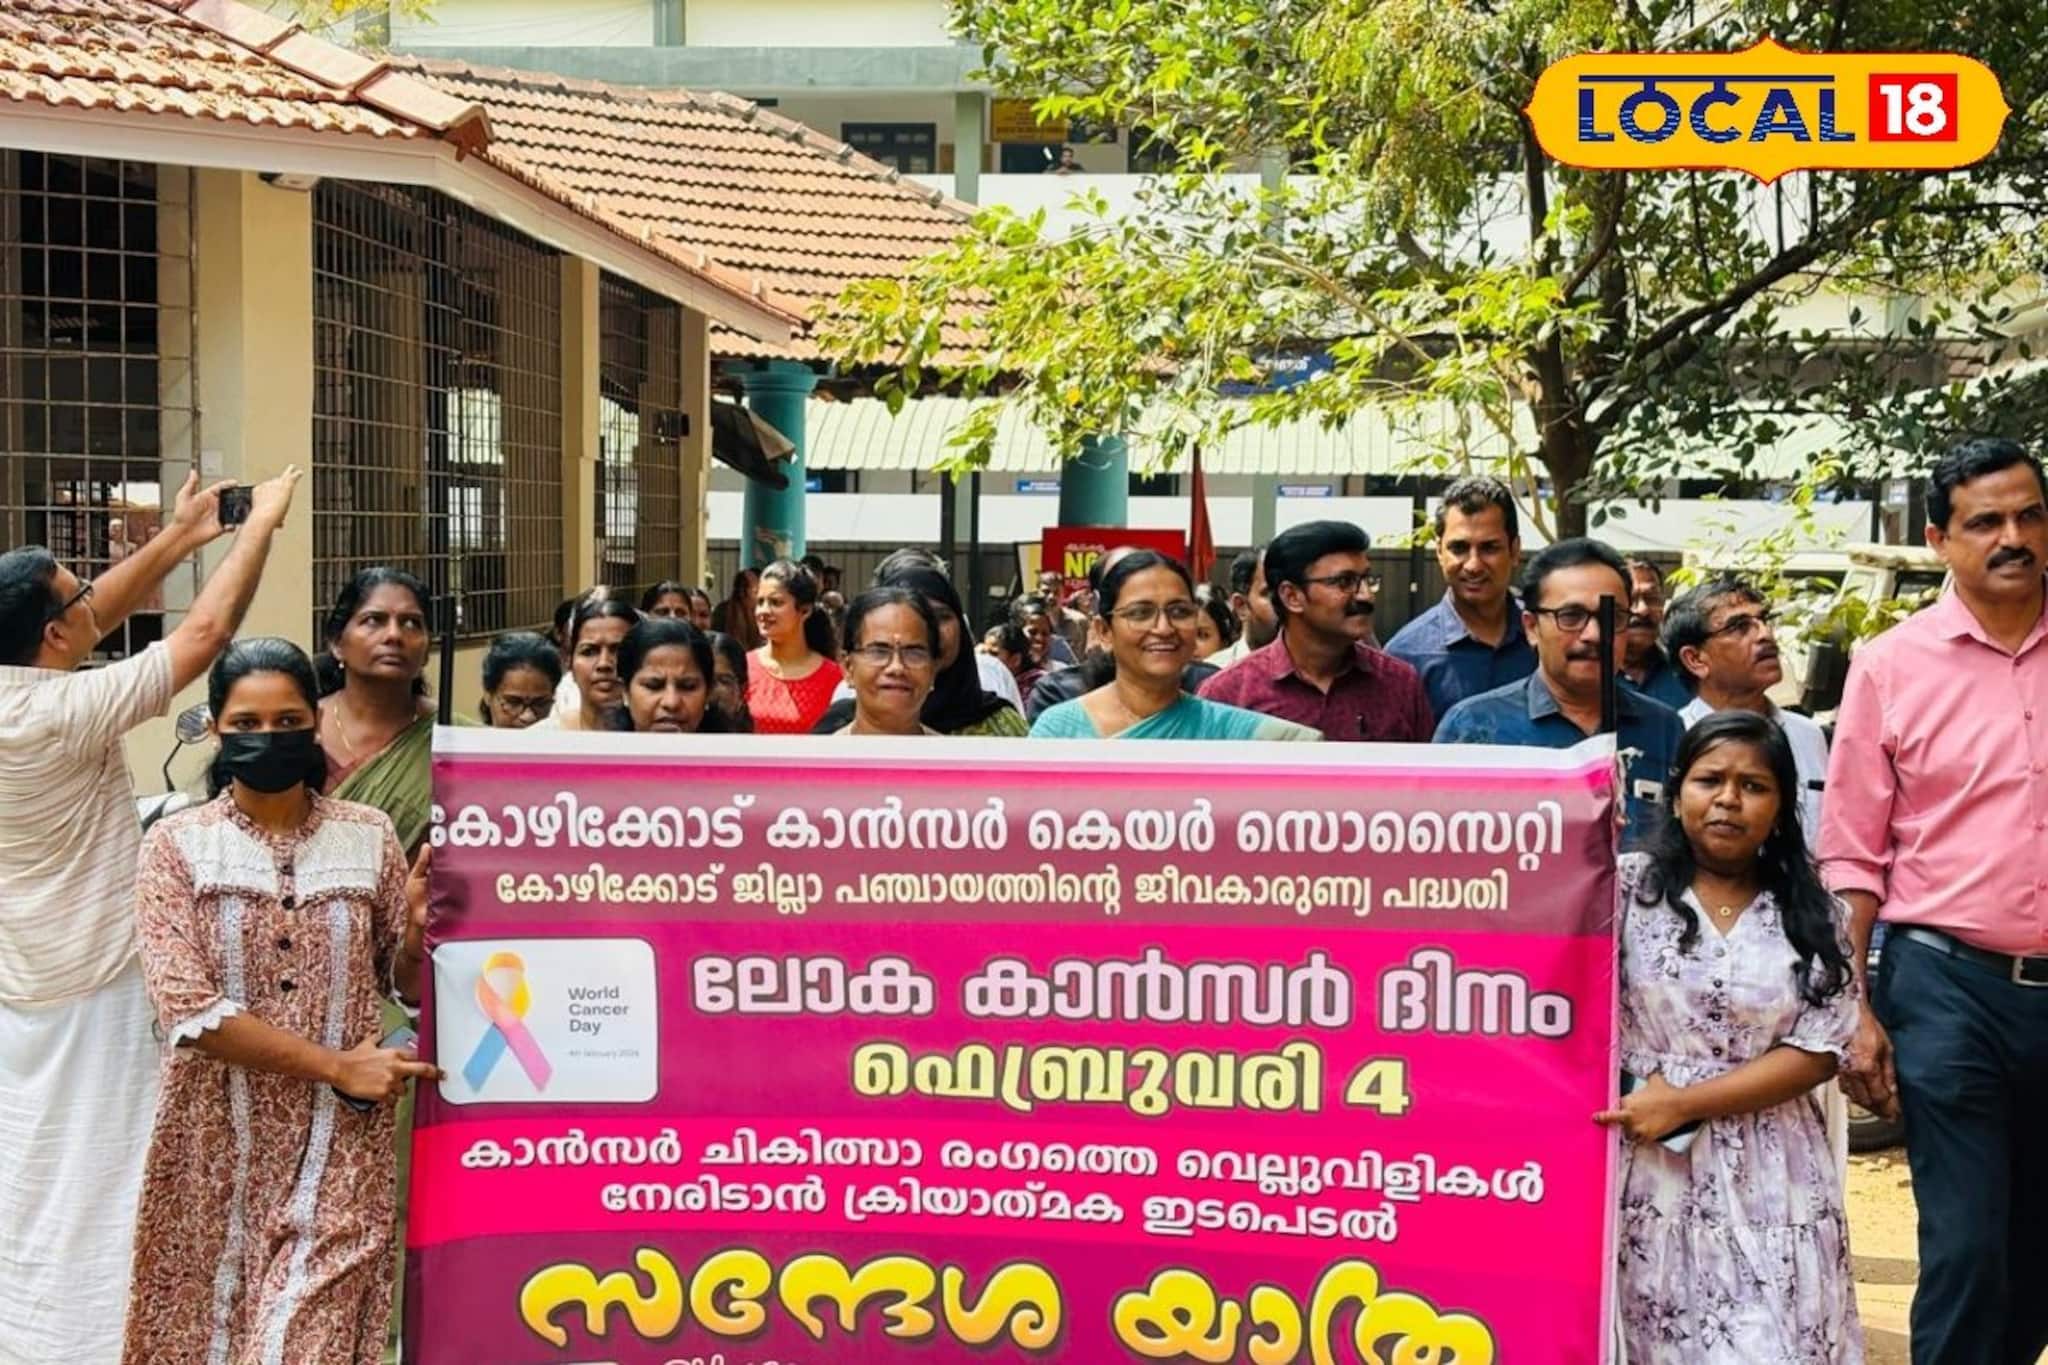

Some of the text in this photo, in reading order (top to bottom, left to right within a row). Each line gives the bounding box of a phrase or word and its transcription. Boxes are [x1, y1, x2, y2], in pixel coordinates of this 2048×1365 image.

[431, 791, 1563, 872] കോഴിക്കോട് കാൻസർ കെയർ സൊസൈറ്റി
[496, 863, 724, 902] കോഴിക്കോട്
[732, 868, 823, 914] ജില്ലാ
[1135, 865, 1371, 917] ജീവകാരുണ്യ
[1383, 868, 1508, 910] പദ്ധതി
[568, 985, 620, 1000] World
[569, 1004, 629, 1016] Cancer
[570, 1019, 602, 1036] Day
[692, 949, 1571, 1036] ലോക കാൻസർ ദിനം
[853, 1042, 1410, 1115] ഫെബ്രുവരി 4
[461, 1128, 1544, 1203] കാൻസർ ചികിത്സാ രംഗത്തെ വെല്ലുവിളികൾ
[602, 1175, 826, 1213] നേരിടാൻ
[1144, 1192, 1398, 1242] ഇടപെടൽ
[520, 1248, 1062, 1348] സന്ദേശ
